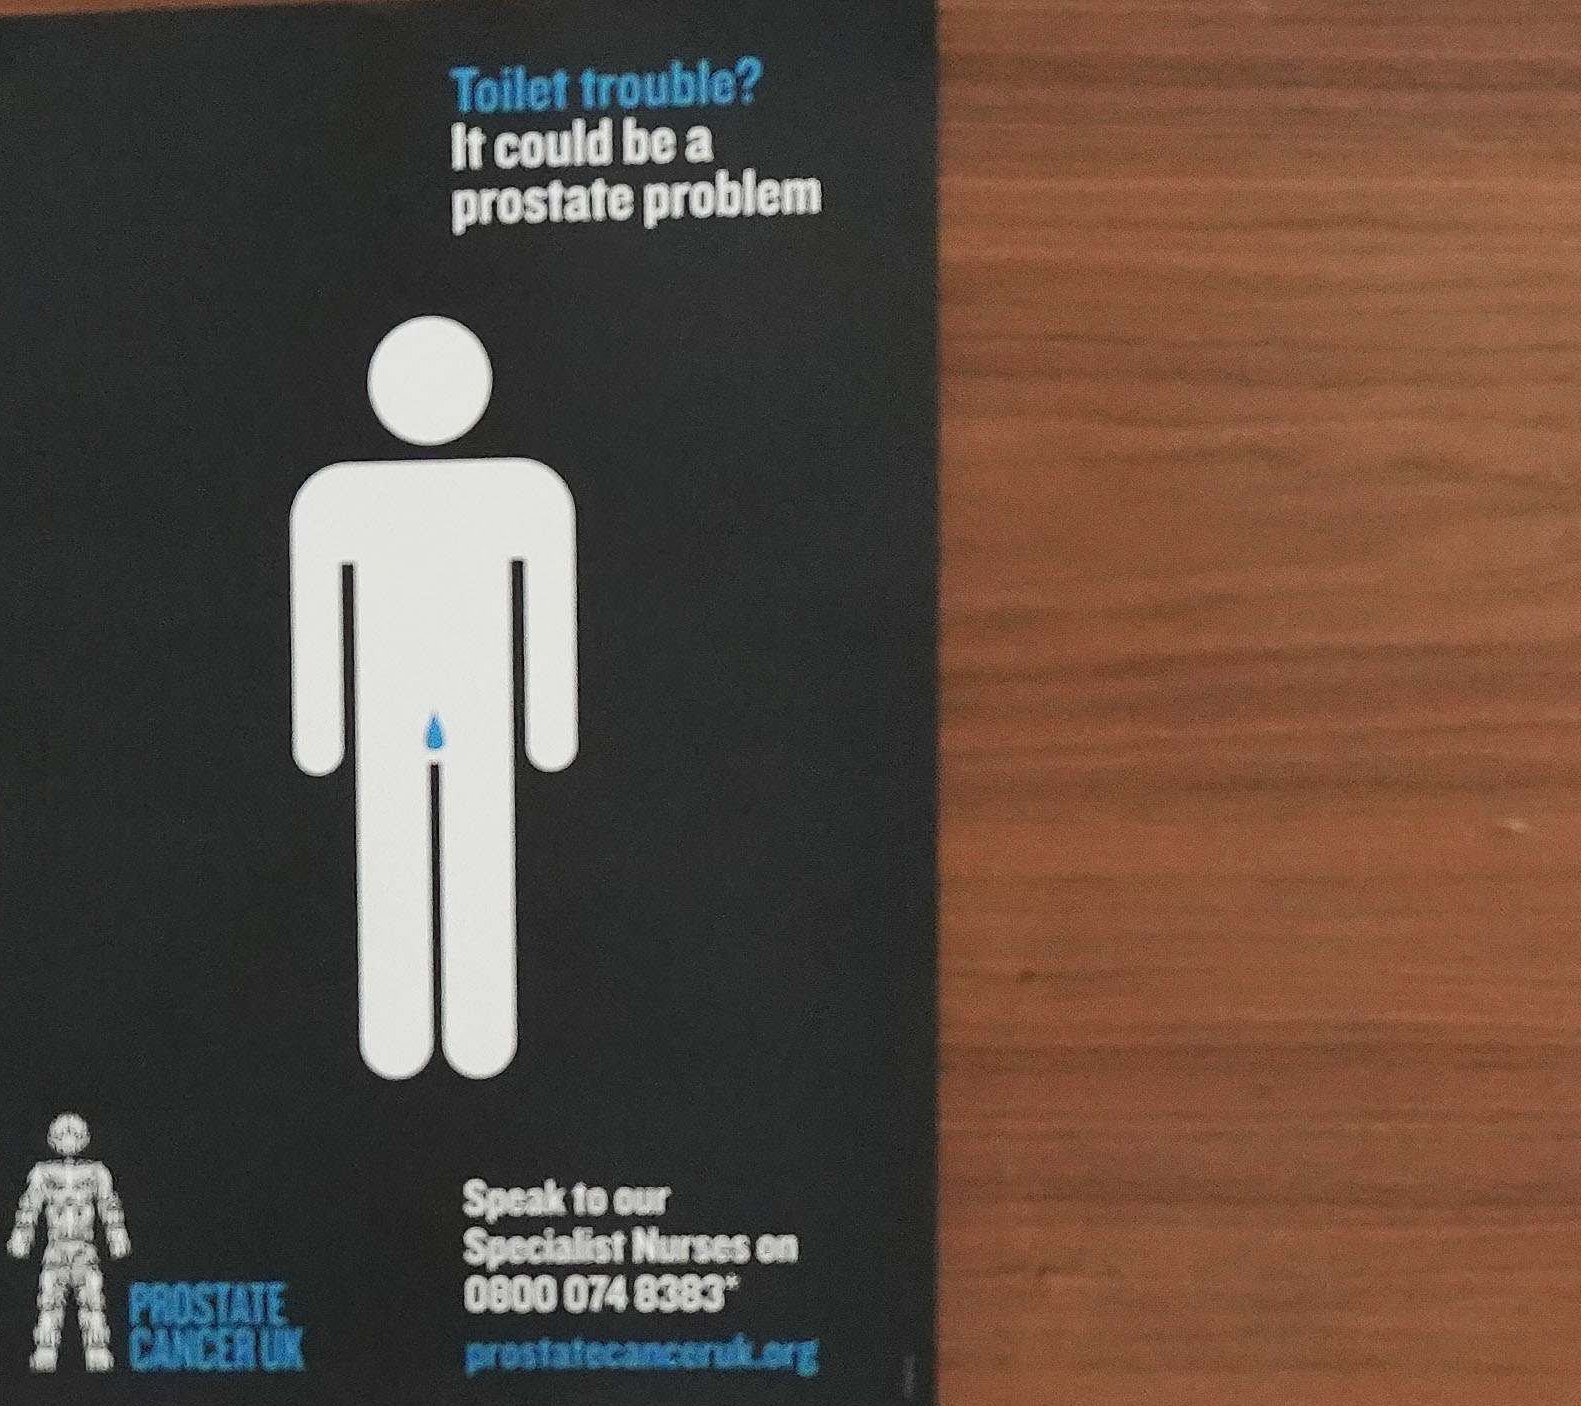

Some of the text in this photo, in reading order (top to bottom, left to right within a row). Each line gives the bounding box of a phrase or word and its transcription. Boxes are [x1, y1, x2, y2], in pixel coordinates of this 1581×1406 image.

[448, 55, 765, 115] Toilet trouble?
[450, 115, 715, 171] It could be a
[451, 167, 824, 236] prostate problem
[462, 1177, 673, 1225] Speak to our
[462, 1225, 800, 1272] Specialist Nurses on
[128, 1280, 289, 1326] PROSTATE
[463, 1273, 558, 1314] 0800
[562, 1273, 630, 1314] 074
[128, 1325, 307, 1373] CANCER UK
[464, 1332, 821, 1379] prostatecanceruk.org
